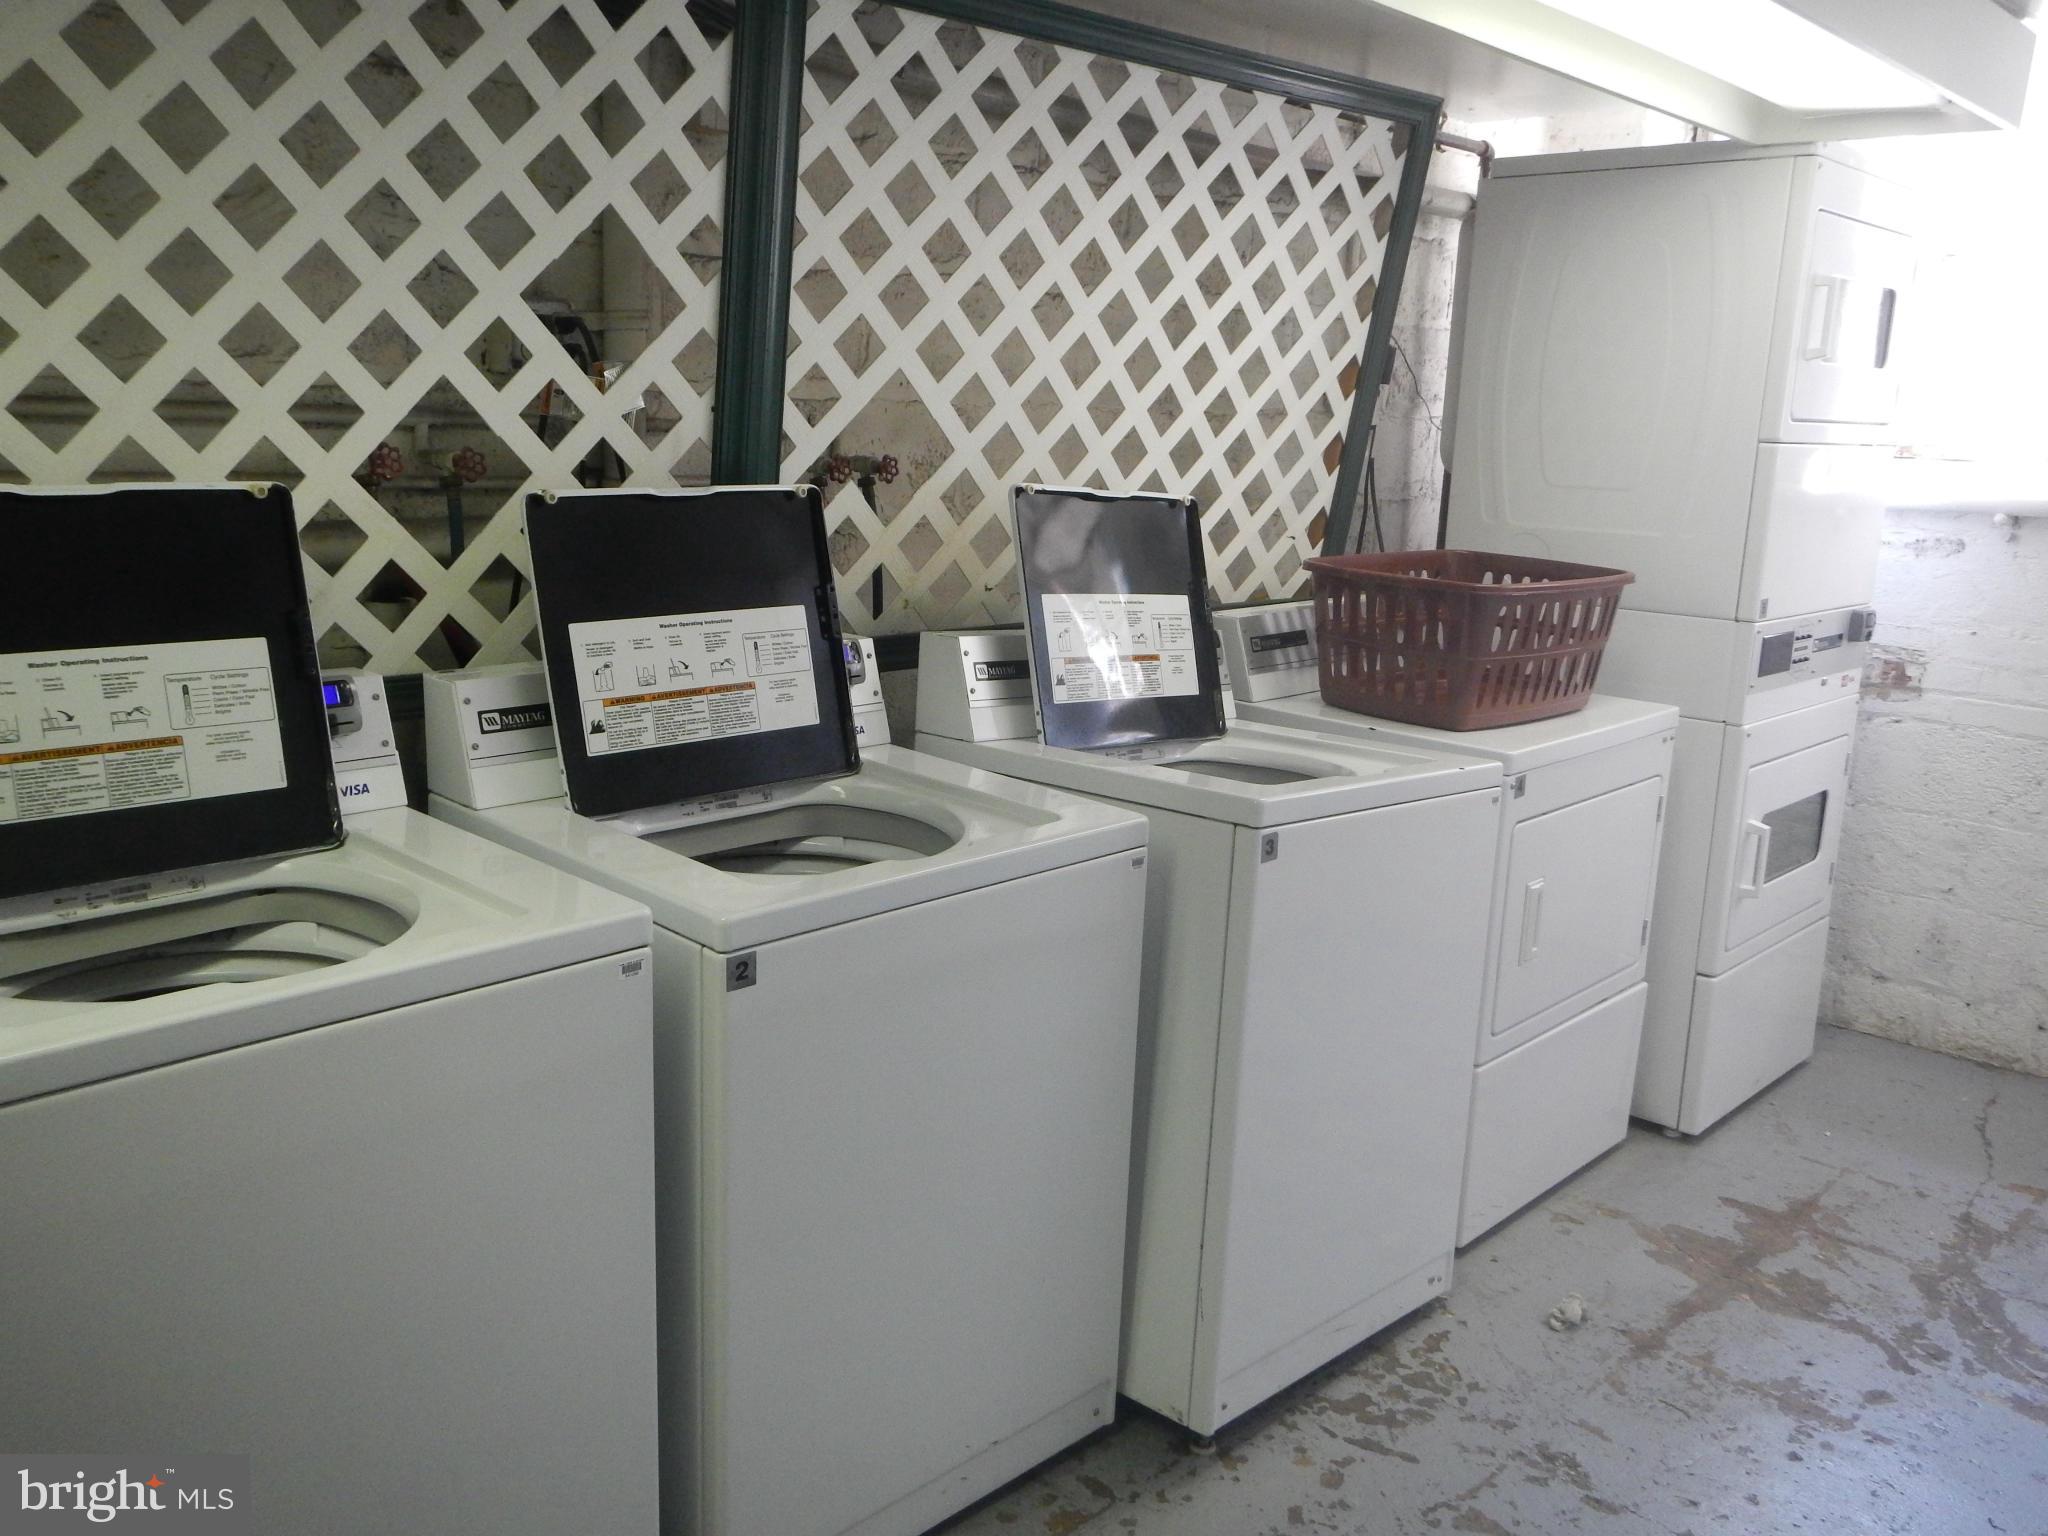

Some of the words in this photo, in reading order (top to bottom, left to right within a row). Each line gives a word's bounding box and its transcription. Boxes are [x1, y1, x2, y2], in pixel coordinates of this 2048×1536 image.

[60, 659, 100, 667] Operating
[102, 655, 149, 663] Instructions
[501, 712, 545, 725] MAYTAG
[340, 783, 370, 797] VISA
[1266, 839, 1274, 855] 3
[736, 961, 749, 981] 2
